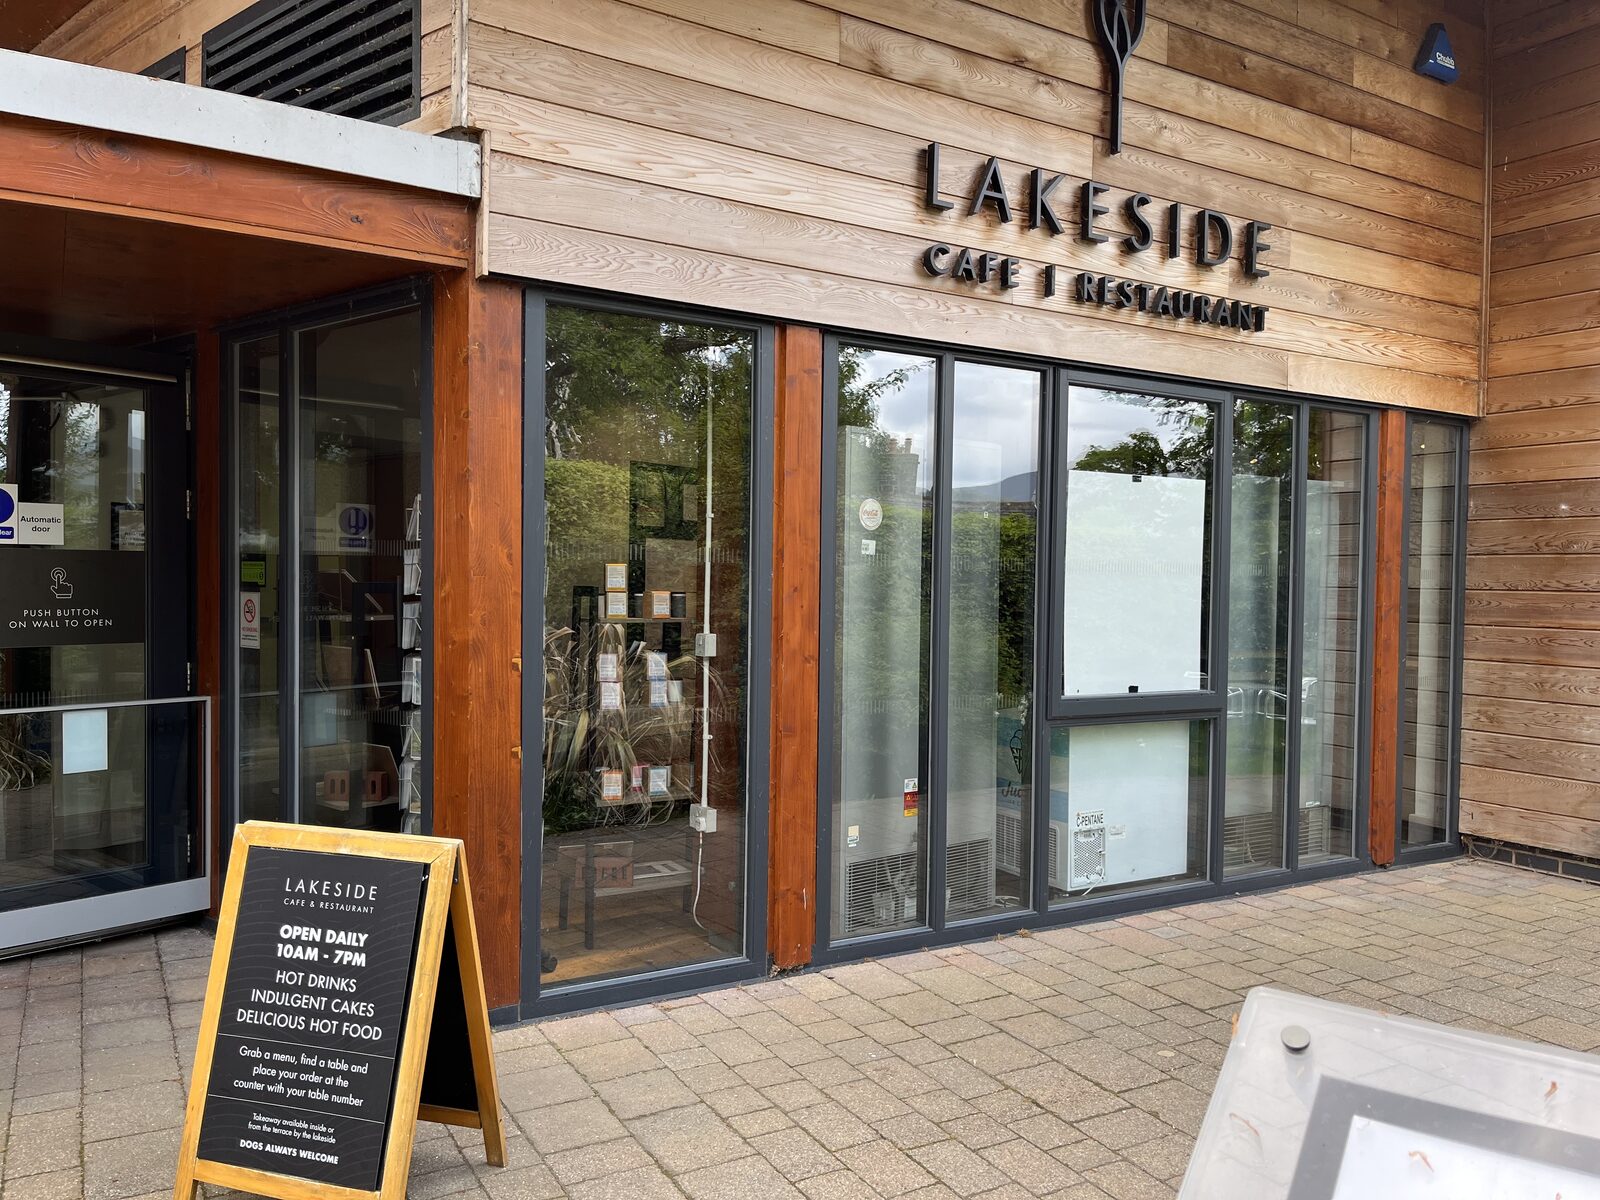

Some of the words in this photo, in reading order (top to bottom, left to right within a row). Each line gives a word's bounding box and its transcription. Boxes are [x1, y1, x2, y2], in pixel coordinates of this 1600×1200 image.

[925, 142, 1273, 279] LAKESIDE
[922, 242, 1020, 290] CAFE
[1075, 271, 1270, 333] RESTAURANT
[20, 515, 62, 524] Automatic
[8, 620, 27, 629] ON
[32, 620, 60, 628] WALL
[64, 619, 79, 627] TO
[83, 619, 113, 627] OPEN
[23, 609, 51, 617] PUSH
[56, 608, 99, 617] BUTTON
[285, 877, 378, 901] LAKESIDE
[283, 898, 306, 907] CAFE
[309, 900, 315, 908] &
[319, 901, 375, 914] RESTAURANT
[279, 924, 322, 942] OPEN
[325, 929, 369, 947] DAILY
[277, 943, 319, 961] 10AM
[333, 949, 366, 967] 7PM
[275, 970, 305, 986] HOT
[308, 973, 357, 993] DRINKS
[250, 988, 328, 1011] INDULGENT
[331, 998, 375, 1018] CAKES
[236, 1008, 306, 1031] DELICIOUS
[309, 1018, 339, 1035] HOT
[341, 1022, 383, 1041] FOOD
[239, 1045, 262, 1059] Grab
[264, 1051, 271, 1060] a
[272, 1053, 298, 1065] menu,
[300, 1053, 318, 1067] find
[318, 1059, 326, 1068] a
[327, 1058, 350, 1072] table
[350, 1062, 369, 1075] and
[252, 1063, 277, 1077] place
[278, 1069, 299, 1081] your
[299, 1071, 324, 1084] order
[324, 1075, 335, 1086] at
[335, 1075, 350, 1089] the
[233, 1079, 265, 1091] counter
[266, 1082, 286, 1095] with
[286, 1086, 307, 1098] your
[307, 1089, 330, 1102] table
[331, 1094, 364, 1107] number
[247, 1121, 262, 1131] from
[262, 1124, 273, 1133] the
[272, 1126, 294, 1137] terrace
[293, 1129, 302, 1140] by
[302, 1130, 313, 1140] the
[312, 1132, 337, 1145] lakeside
[252, 1112, 282, 1126] Takeaway
[281, 1118, 310, 1130] available
[309, 1122, 328, 1133] inside
[239, 1139, 264, 1151] DOGS
[264, 1143, 298, 1157] ALWAYS
[299, 1149, 339, 1165] WELCOME
